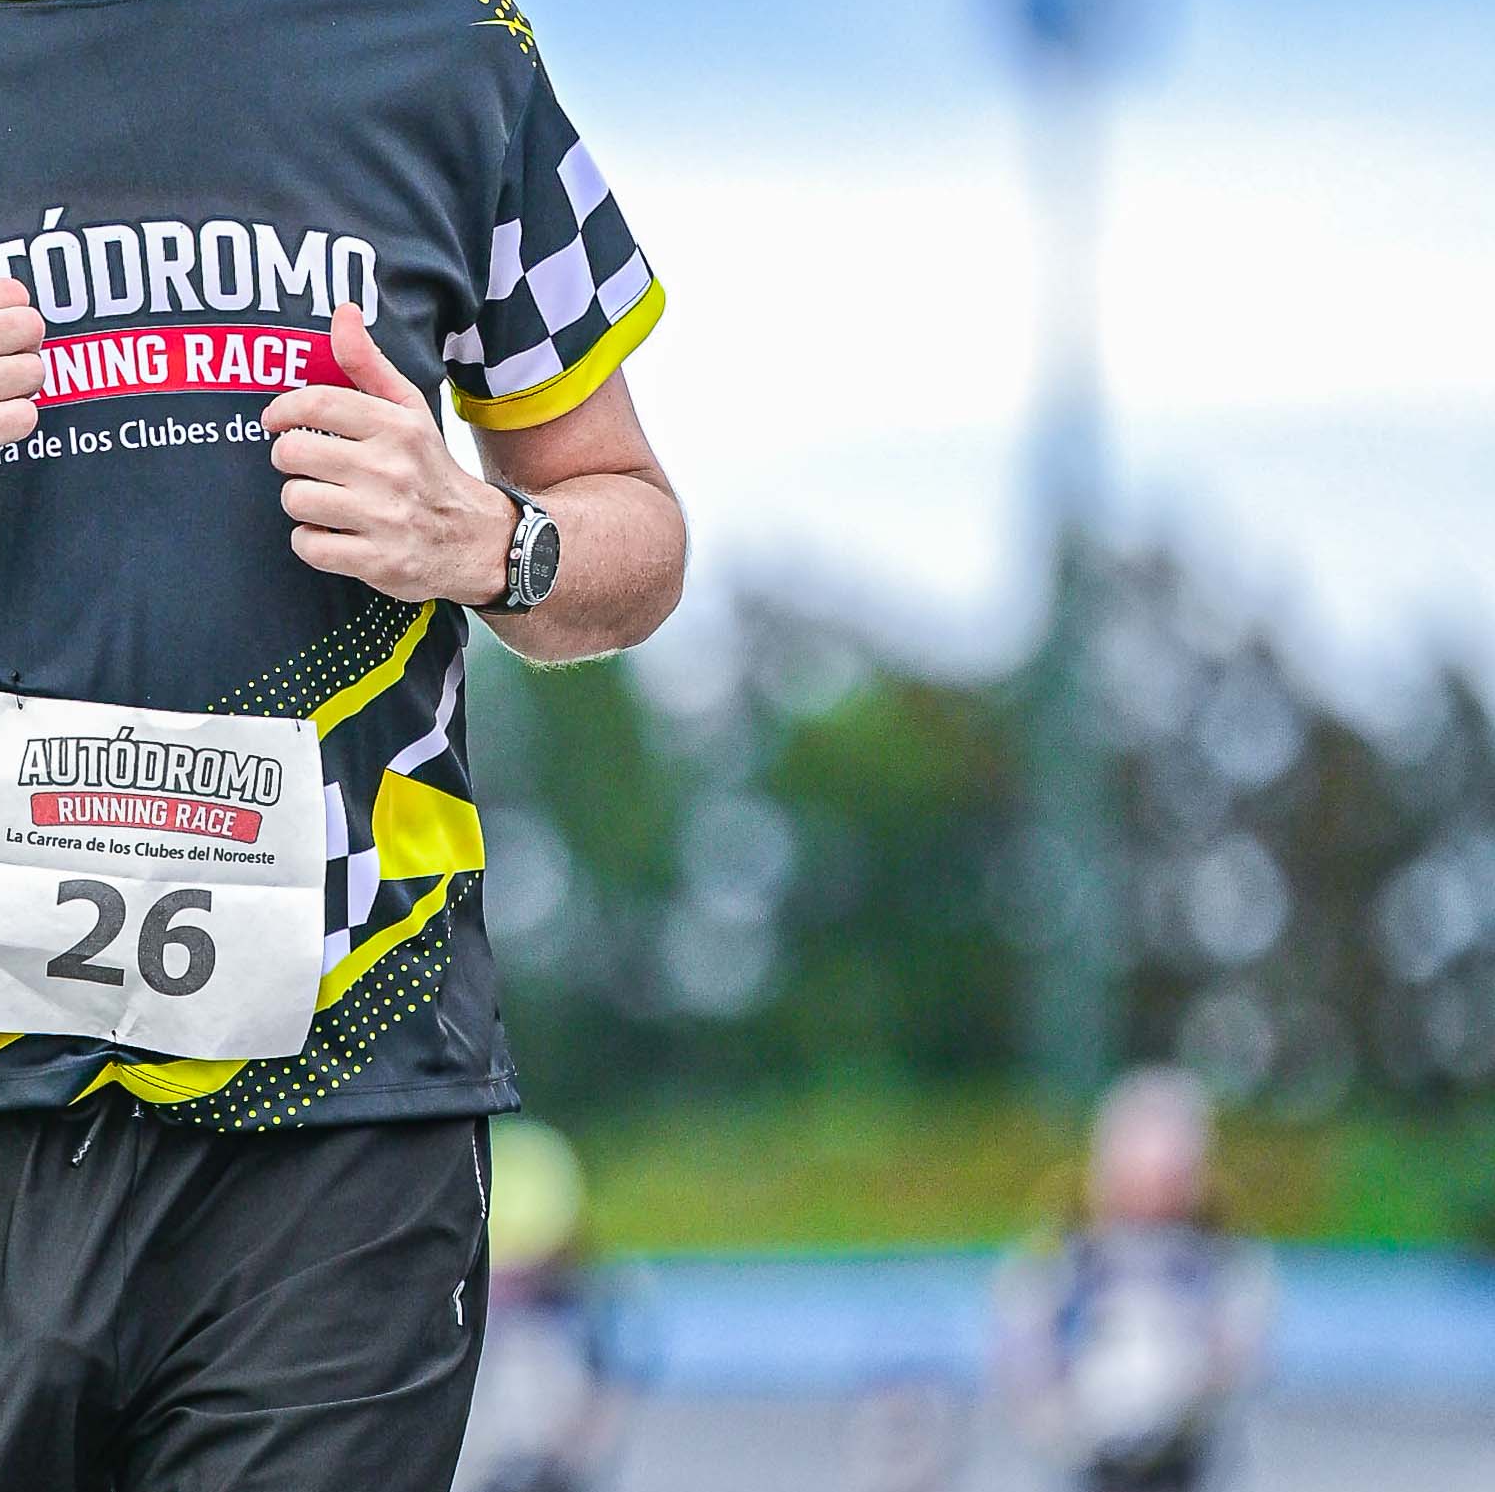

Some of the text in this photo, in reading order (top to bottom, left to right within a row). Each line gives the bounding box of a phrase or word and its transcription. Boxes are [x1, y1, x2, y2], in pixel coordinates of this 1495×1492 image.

[30, 333, 312, 400] NNING RACE
[27, 430, 62, 459] de
[69, 426, 113, 455] los
[118, 417, 220, 449] Clubes
[17, 726, 283, 806] AUTÓDROMO
[57, 796, 238, 837] RUNNING RACE
[6, 828, 276, 865] La Carrera de los Clubes del Noroeste
[45, 879, 217, 997] 26
